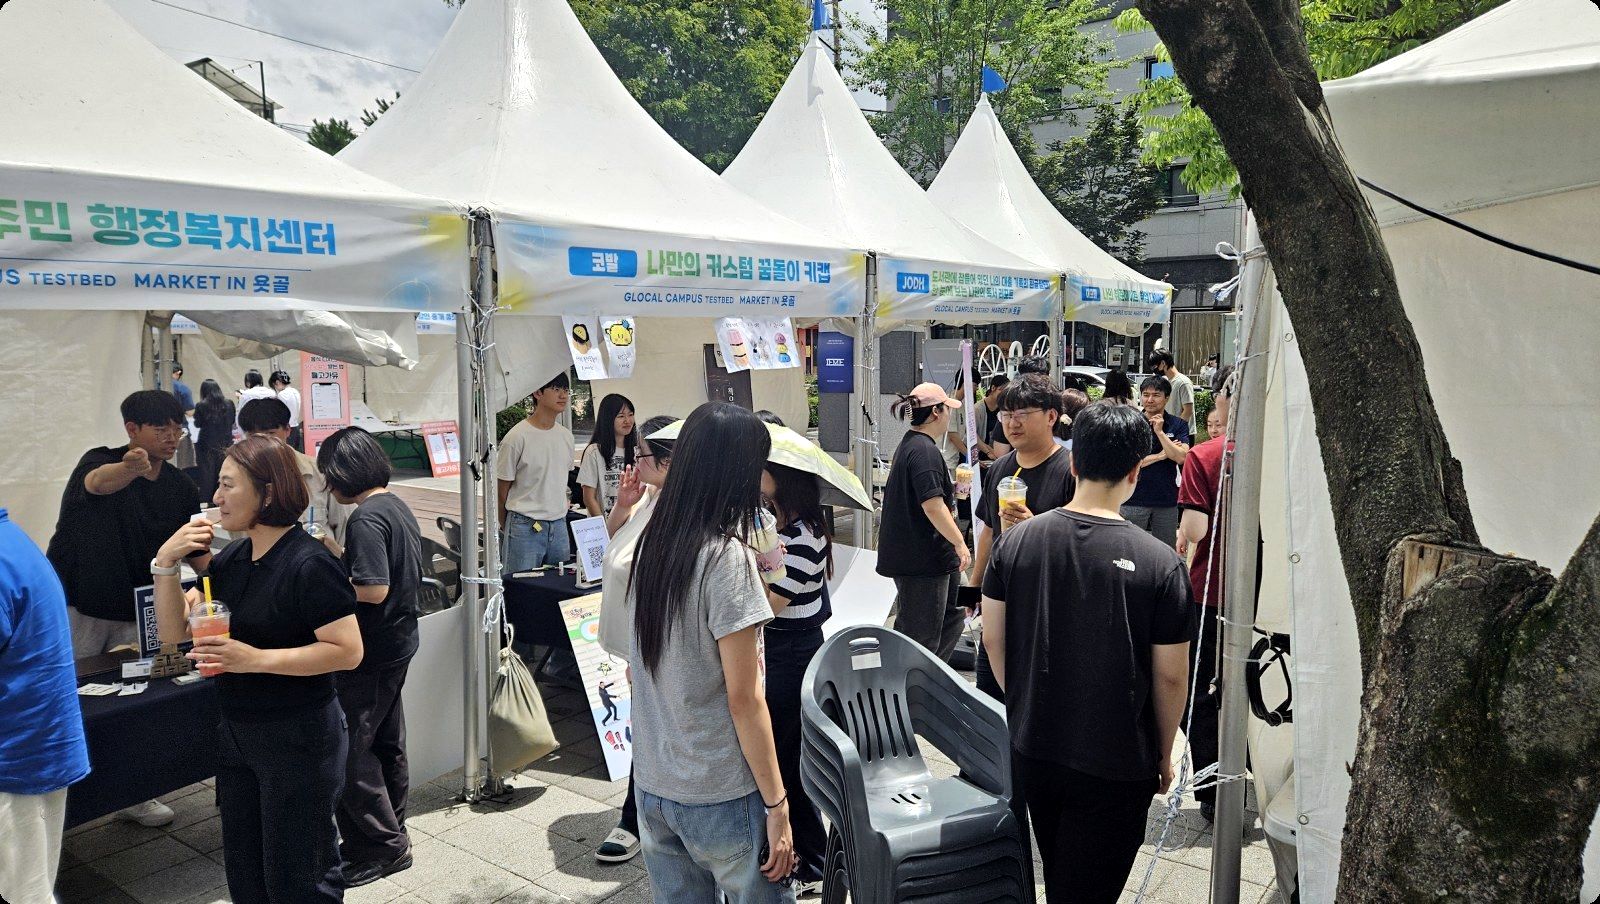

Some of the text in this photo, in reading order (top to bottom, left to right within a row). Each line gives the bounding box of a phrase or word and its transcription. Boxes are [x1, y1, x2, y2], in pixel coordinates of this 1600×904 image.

[87, 203, 337, 256] 행정복지센터
[647, 249, 700, 277] 나만의
[706, 253, 753, 280] 커스텀
[758, 258, 800, 282] 꿈돌이
[804, 261, 831, 284] 키캡
[29, 272, 116, 287] TESTBED
[134, 273, 221, 290] MARKET
[228, 276, 246, 290] IN
[253, 274, 290, 294] 욧골
[902, 275, 925, 290] JODH
[624, 292, 663, 303] GLOCAL
[665, 293, 703, 304] CAMPUS
[704, 295, 734, 304] TESTBED
[739, 296, 770, 305] MARKET
[771, 296, 780, 305] IN
